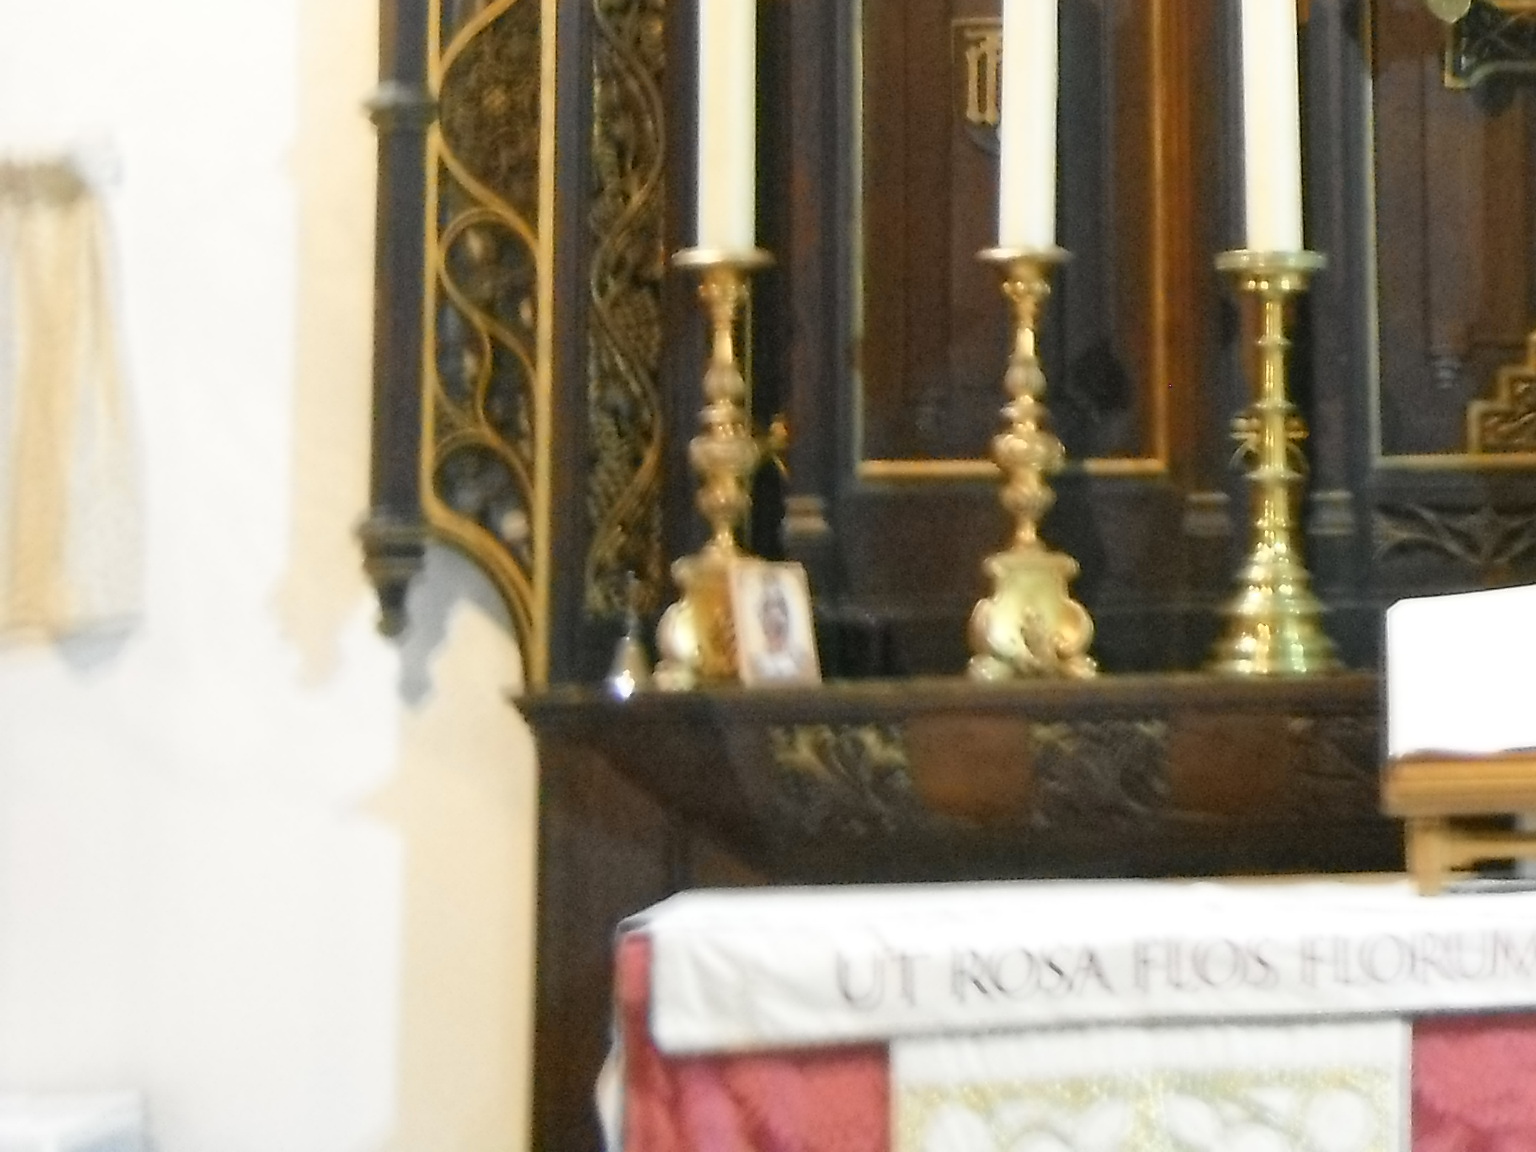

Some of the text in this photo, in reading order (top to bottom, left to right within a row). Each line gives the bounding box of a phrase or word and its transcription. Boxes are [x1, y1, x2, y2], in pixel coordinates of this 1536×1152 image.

[836, 949, 928, 1011] UT
[950, 944, 1113, 1004] ROSA
[1133, 936, 1279, 992] FLOS
